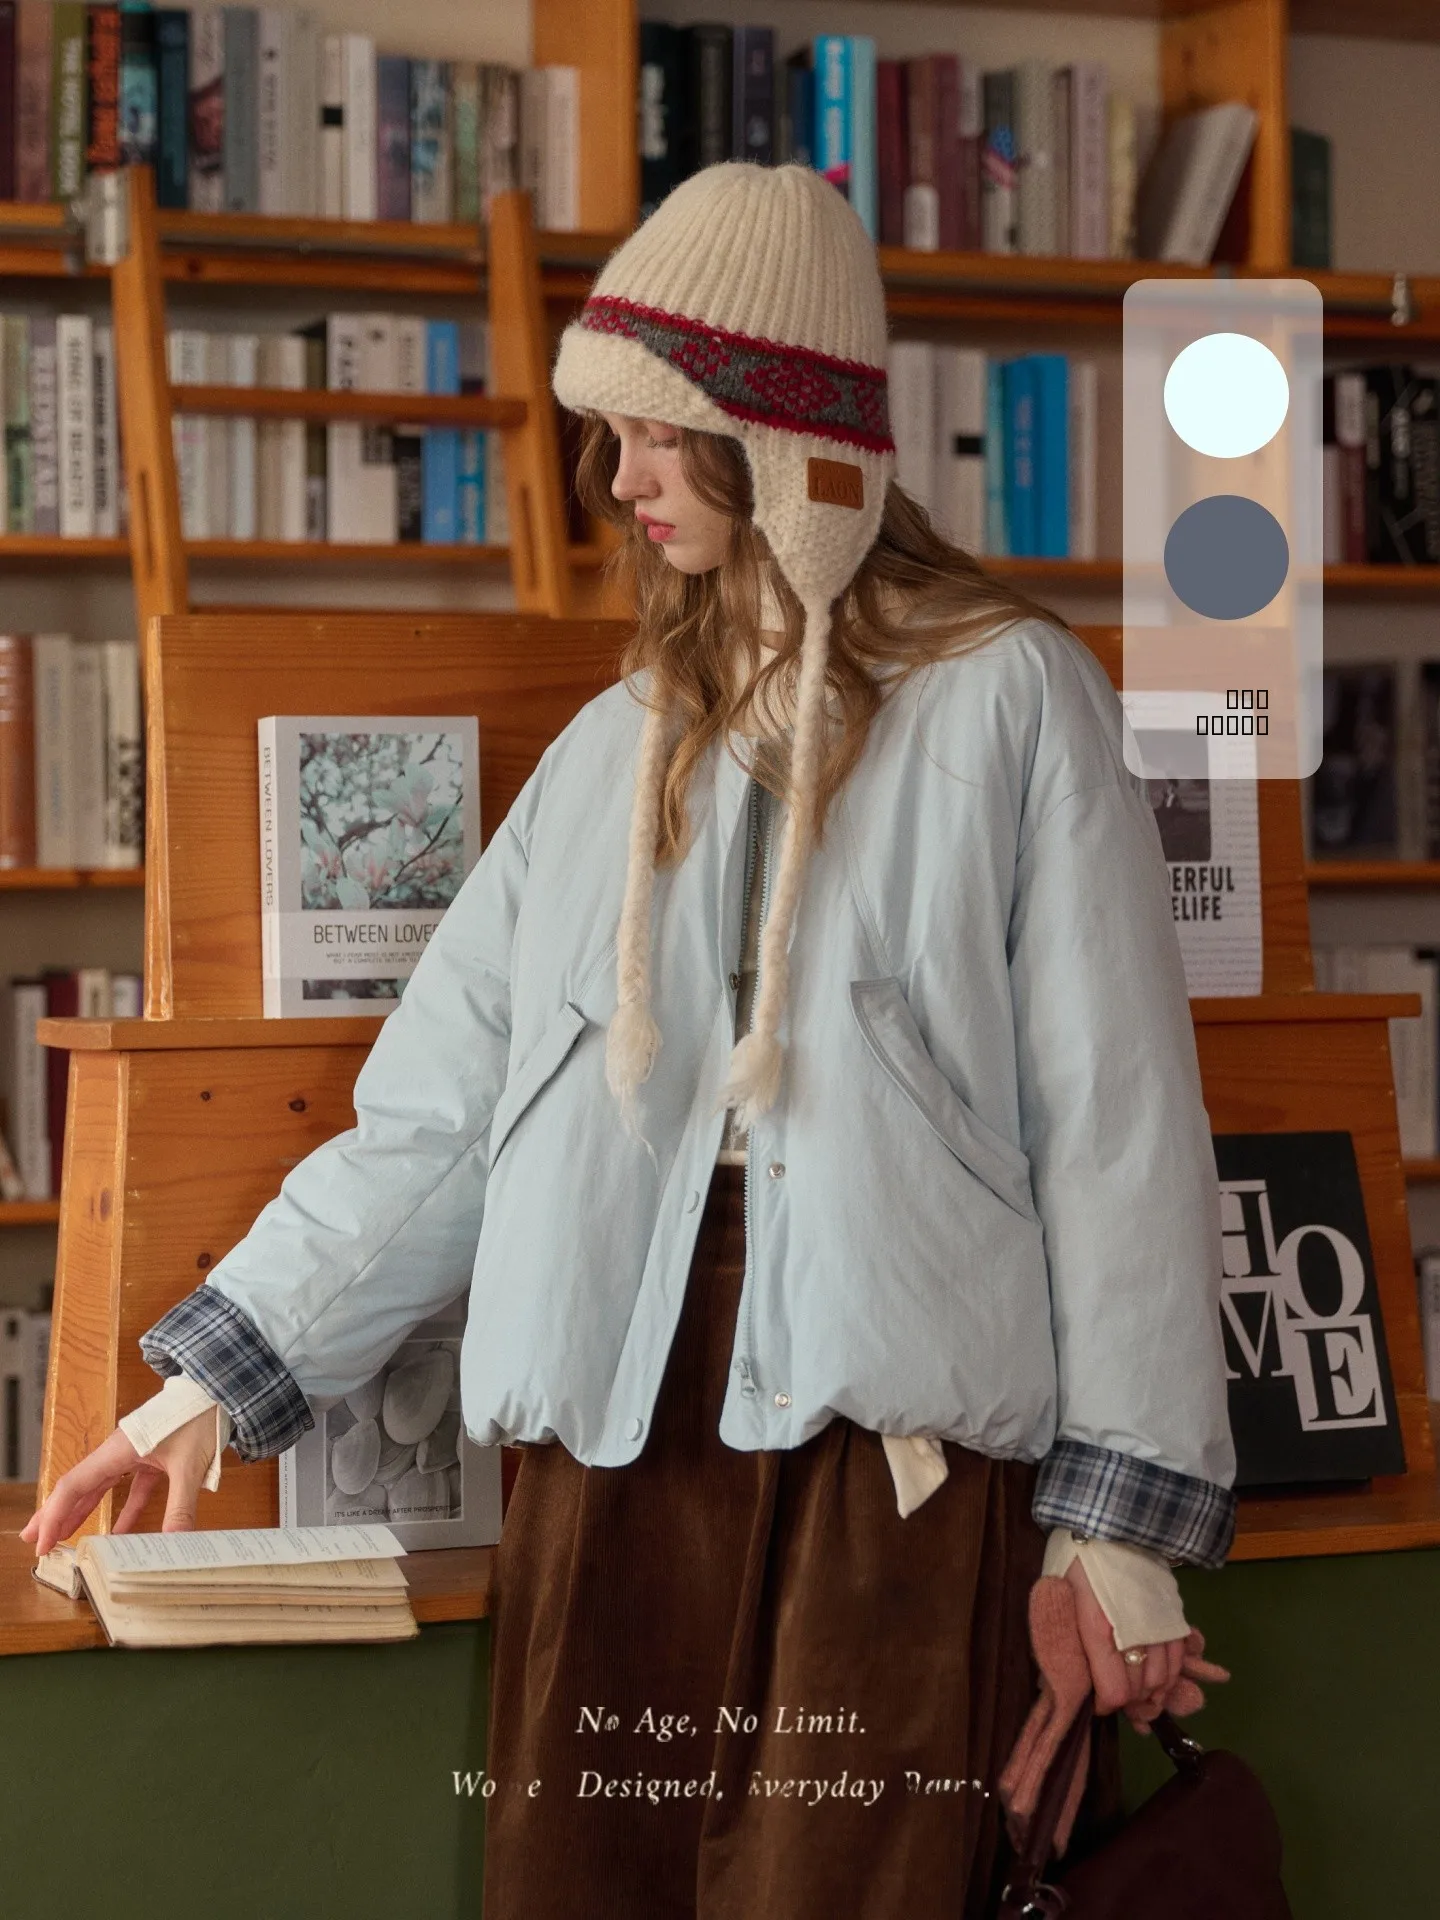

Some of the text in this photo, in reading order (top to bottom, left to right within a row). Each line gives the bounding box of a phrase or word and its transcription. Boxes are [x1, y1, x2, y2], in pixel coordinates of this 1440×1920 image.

[264, 747, 272, 832] BETWEEN
[265, 839, 273, 906] LOVERS
[1172, 866, 1235, 892] ERFUL
[314, 925, 388, 943] BETWEEN
